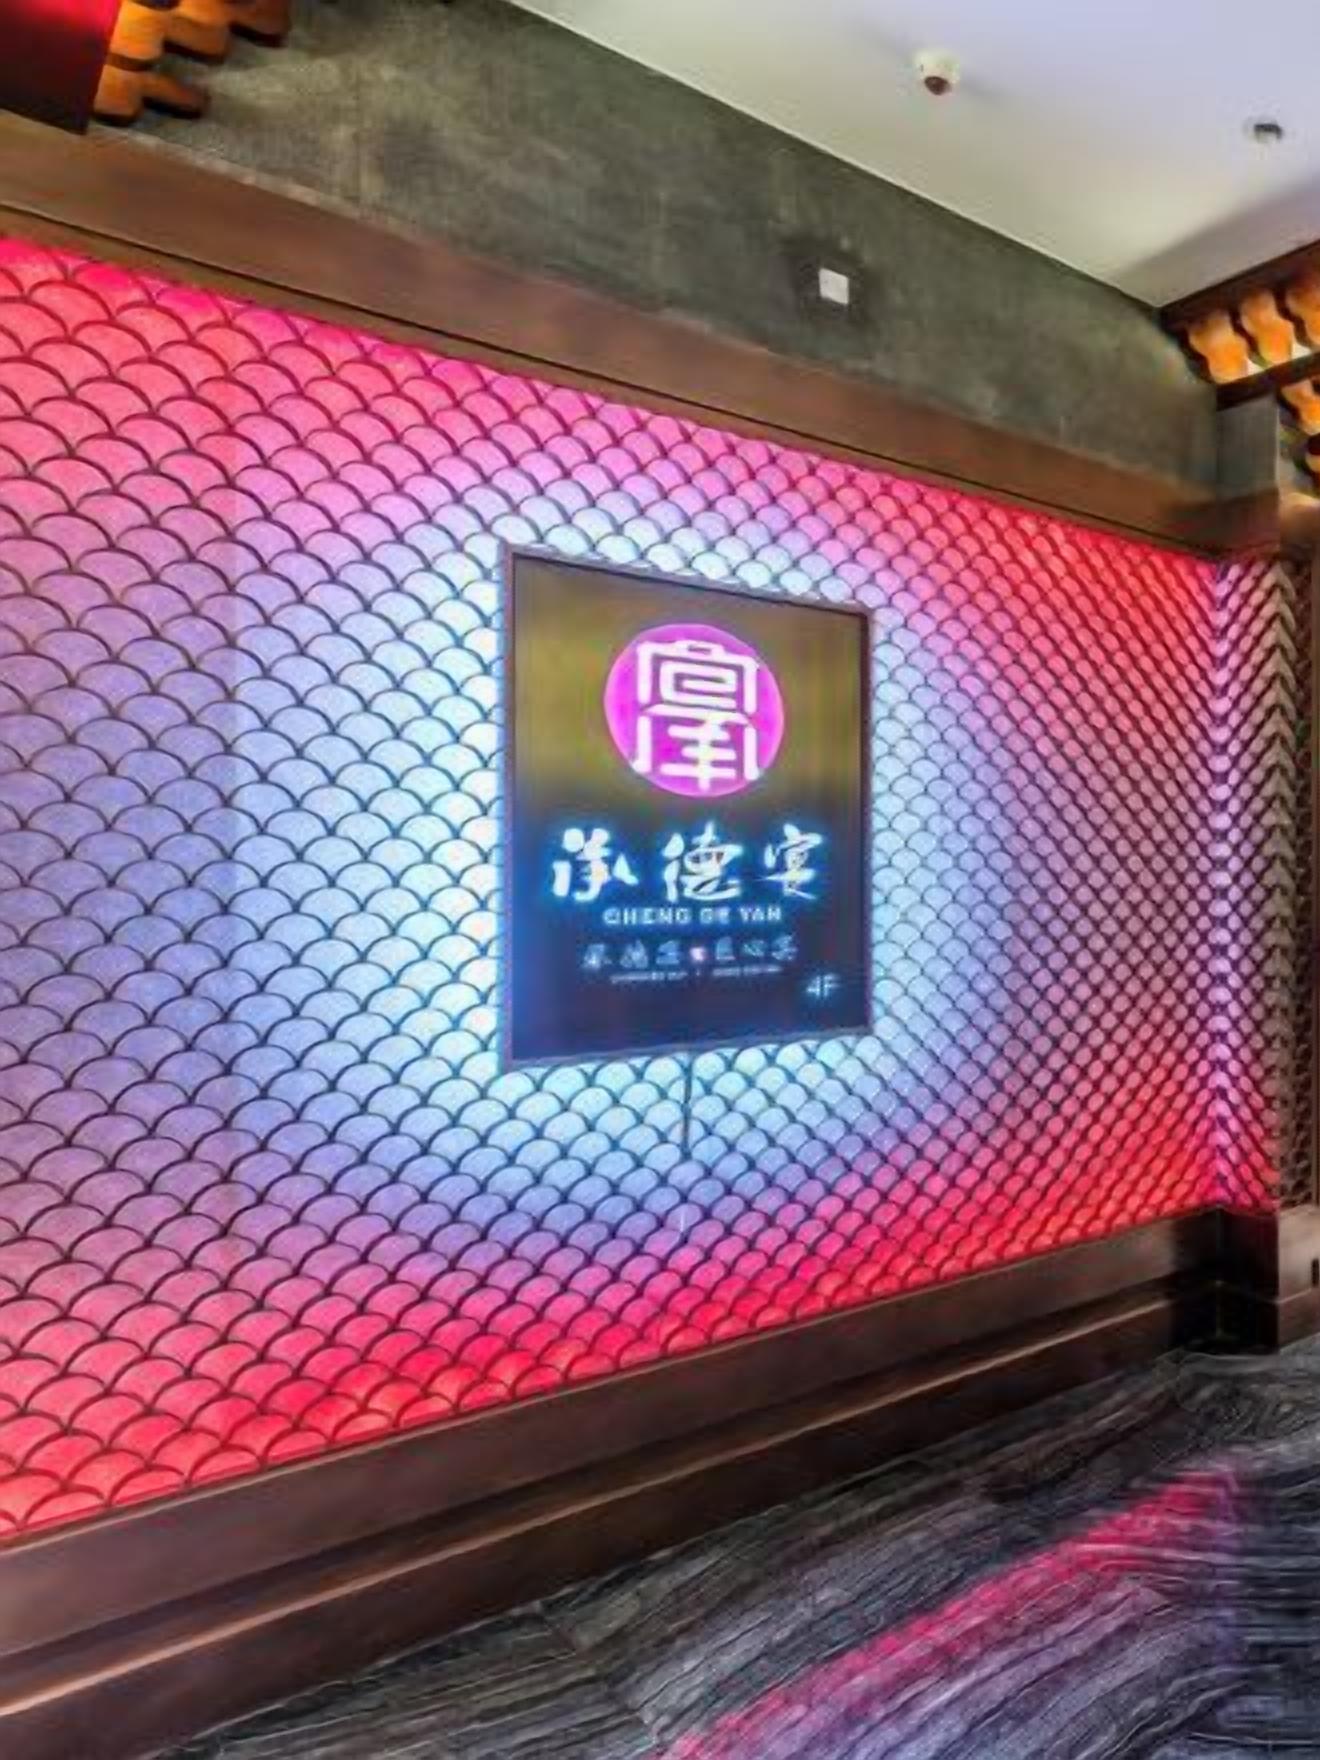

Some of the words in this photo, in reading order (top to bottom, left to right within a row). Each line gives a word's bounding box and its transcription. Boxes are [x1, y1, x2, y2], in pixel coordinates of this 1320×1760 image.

[552, 820, 823, 902] 承德宴
[603, 907, 691, 925] CHENG
[740, 906, 782, 922] YAN
[807, 973, 840, 998] 4F
